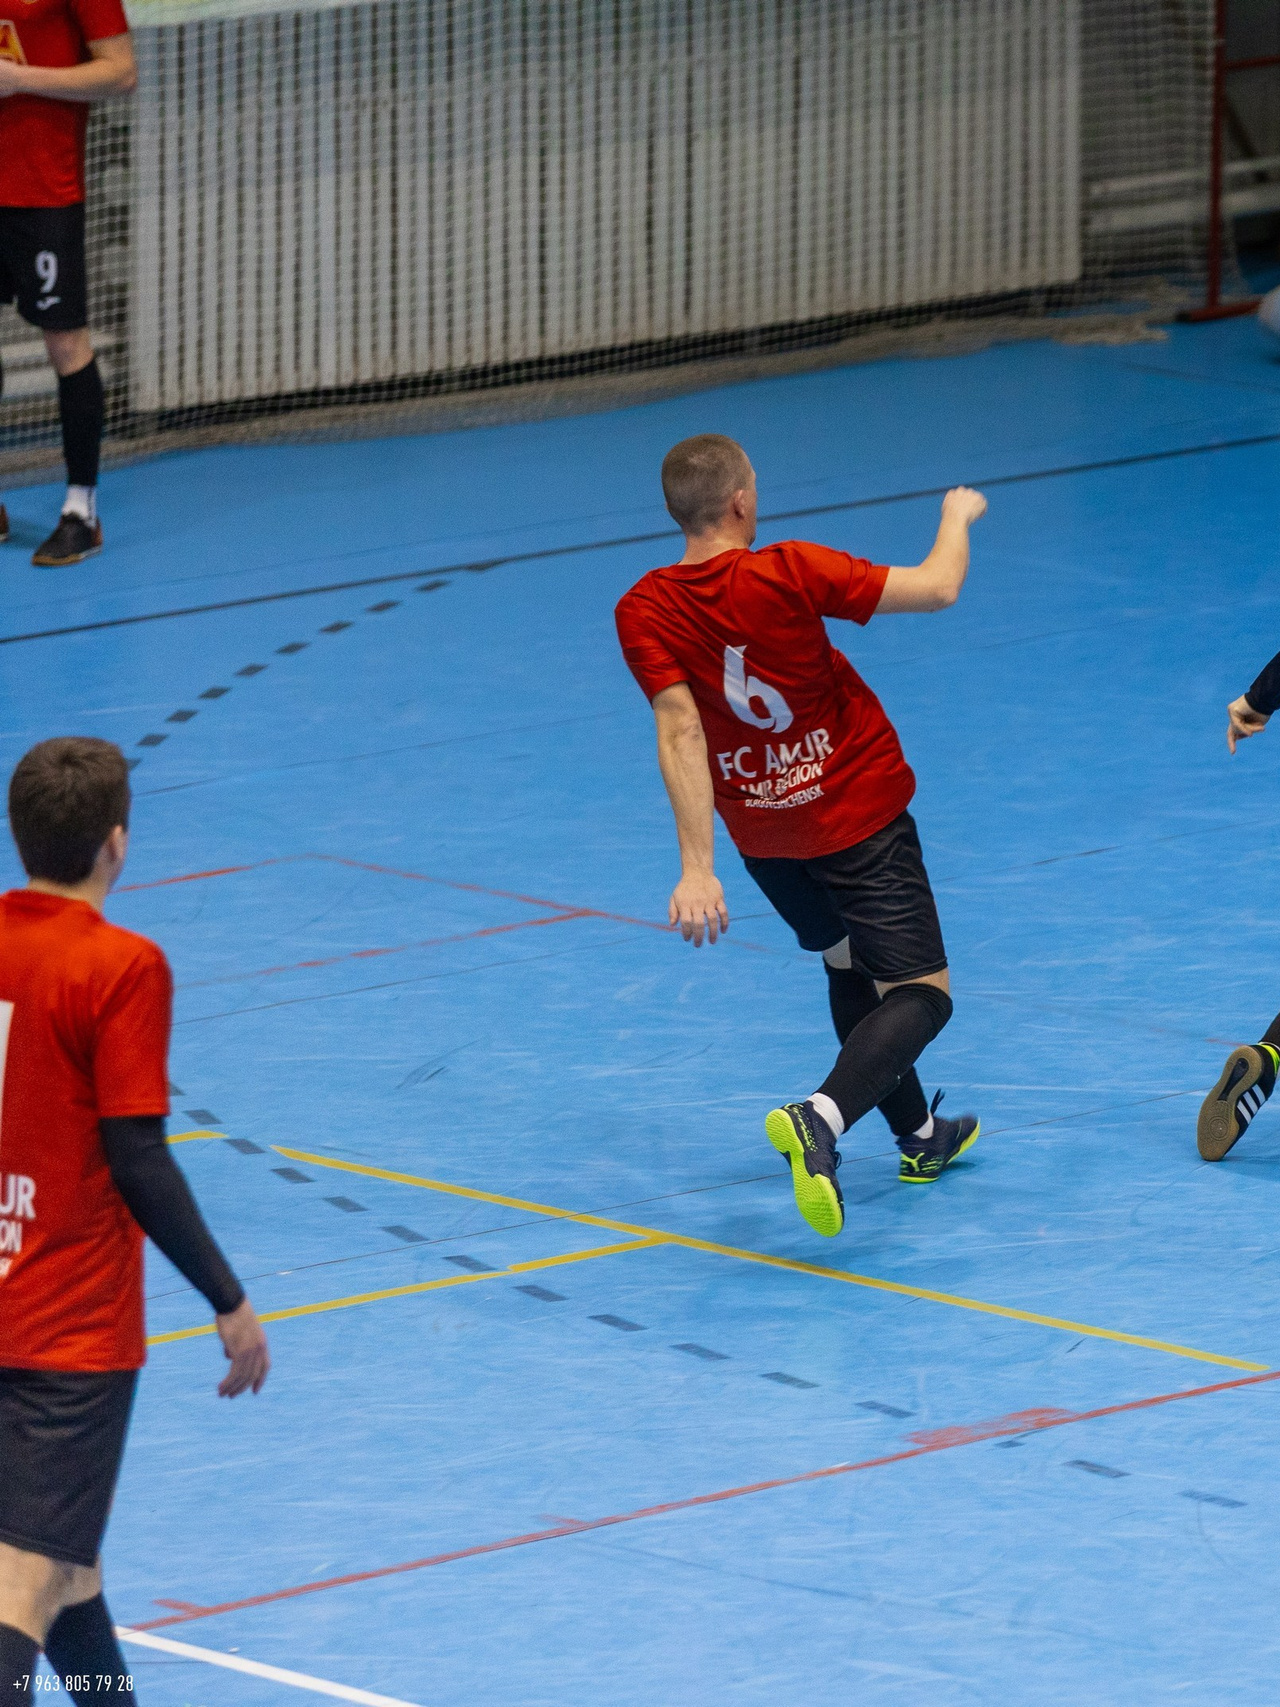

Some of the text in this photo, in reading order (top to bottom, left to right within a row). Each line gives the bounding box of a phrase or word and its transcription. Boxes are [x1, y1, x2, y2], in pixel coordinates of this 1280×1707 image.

[35, 250, 58, 294] 9
[723, 644, 794, 734] 6
[716, 746, 757, 780] FC
